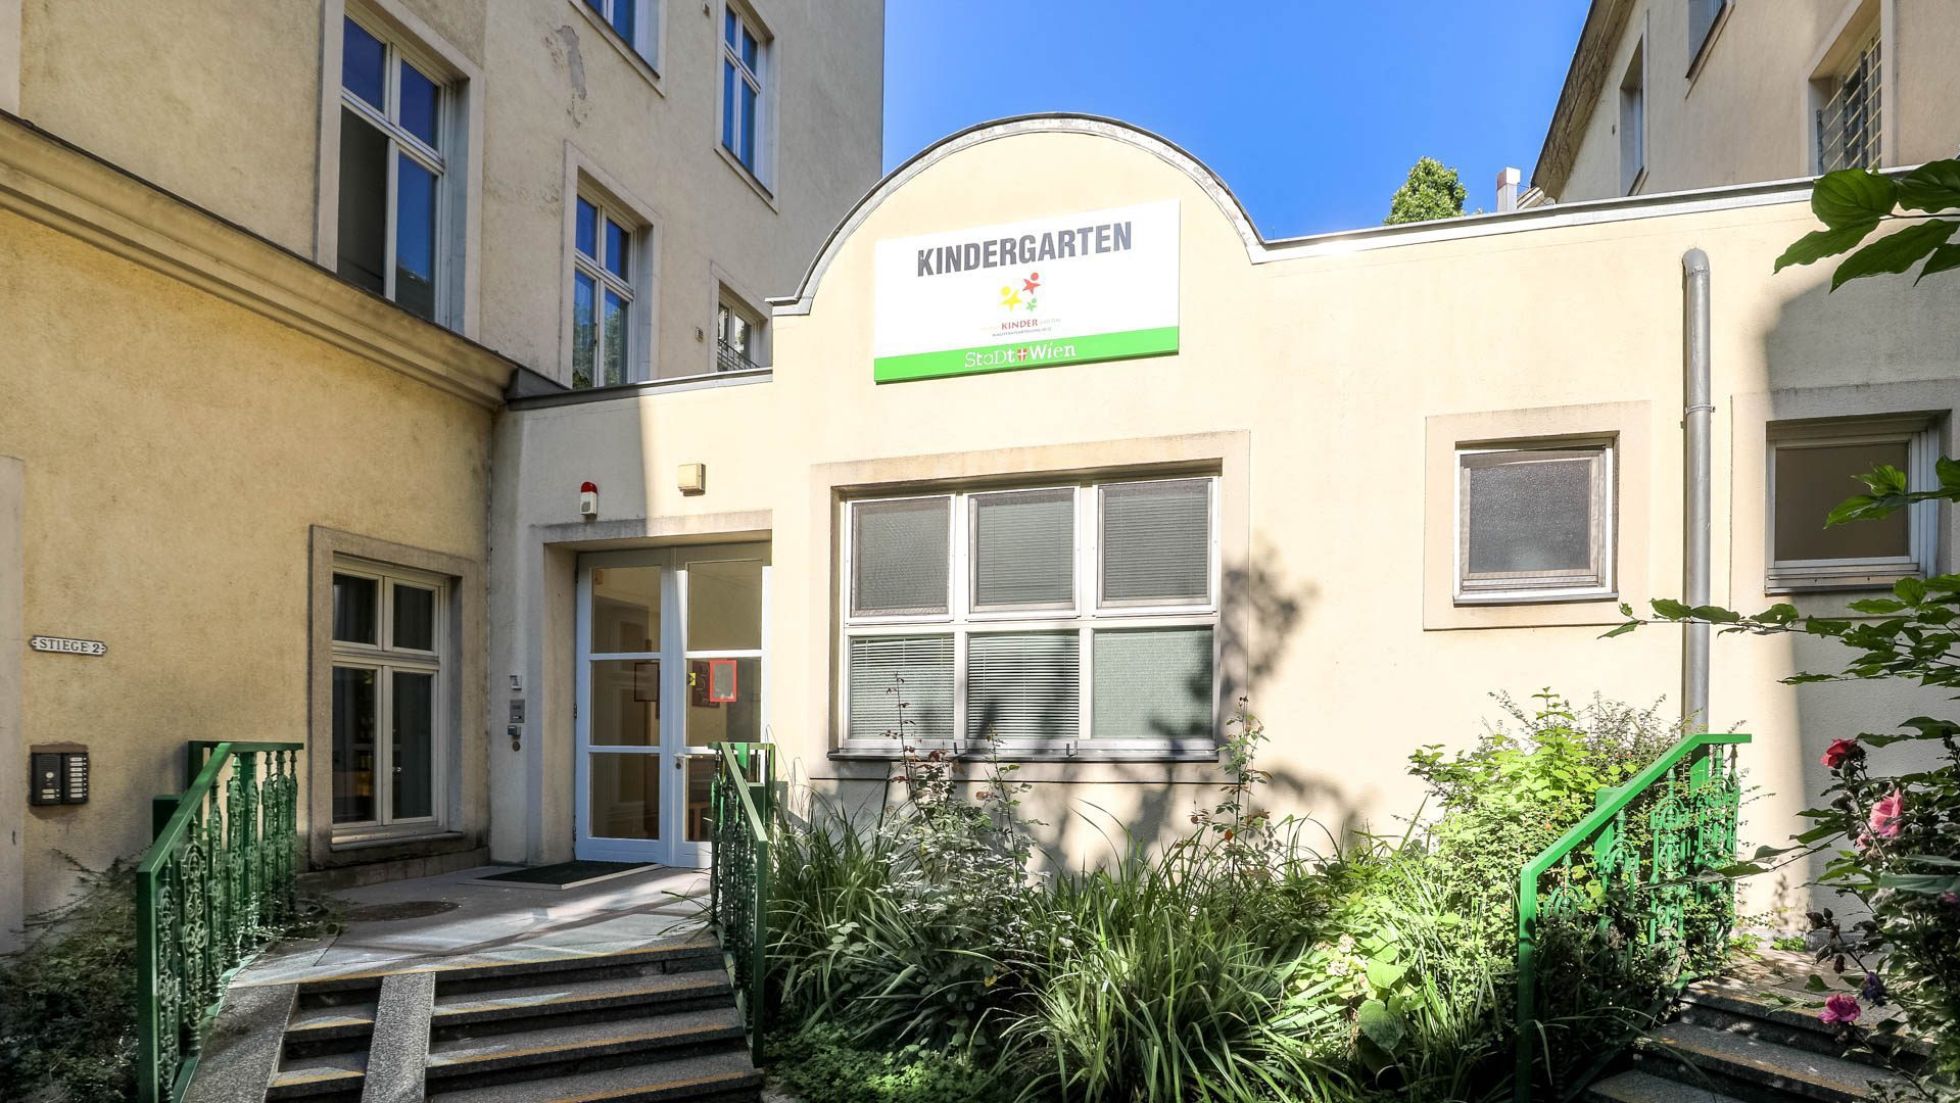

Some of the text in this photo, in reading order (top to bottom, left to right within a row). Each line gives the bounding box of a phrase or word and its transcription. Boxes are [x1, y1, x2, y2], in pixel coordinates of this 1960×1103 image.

[917, 221, 1132, 277] KINDERGARTEN
[1001, 318, 1039, 331] KINDER
[1030, 341, 1076, 361] Wien
[39, 638, 101, 654] STIEGE 2
